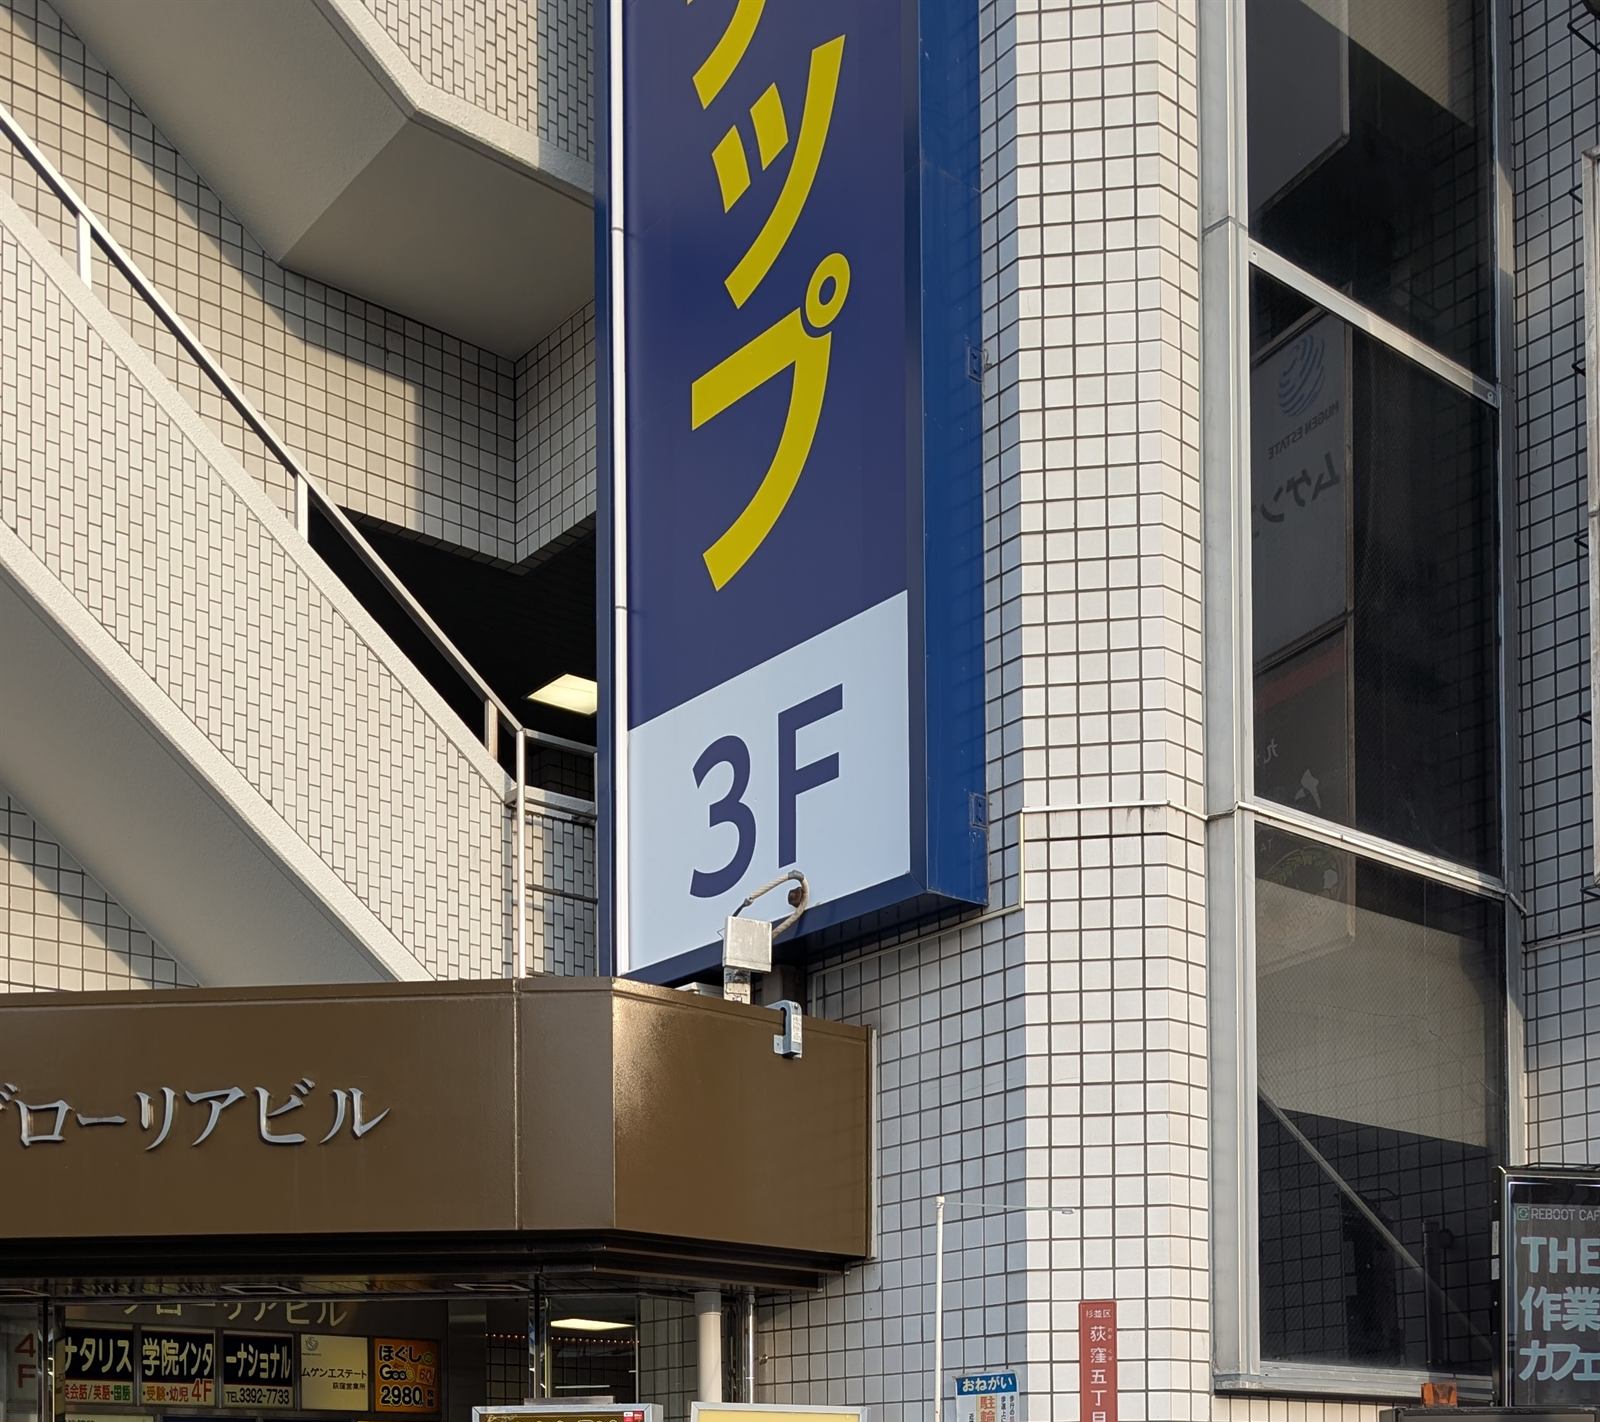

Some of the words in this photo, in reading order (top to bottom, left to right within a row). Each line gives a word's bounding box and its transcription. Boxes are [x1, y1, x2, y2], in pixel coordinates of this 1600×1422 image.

[688, 683, 844, 900] 3F
[1531, 1207, 1576, 1221] REBOOT
[1519, 1285, 1600, 1333] 作業
[191, 1378, 213, 1402] 4F
[962, 1376, 1013, 1393] おねがい
